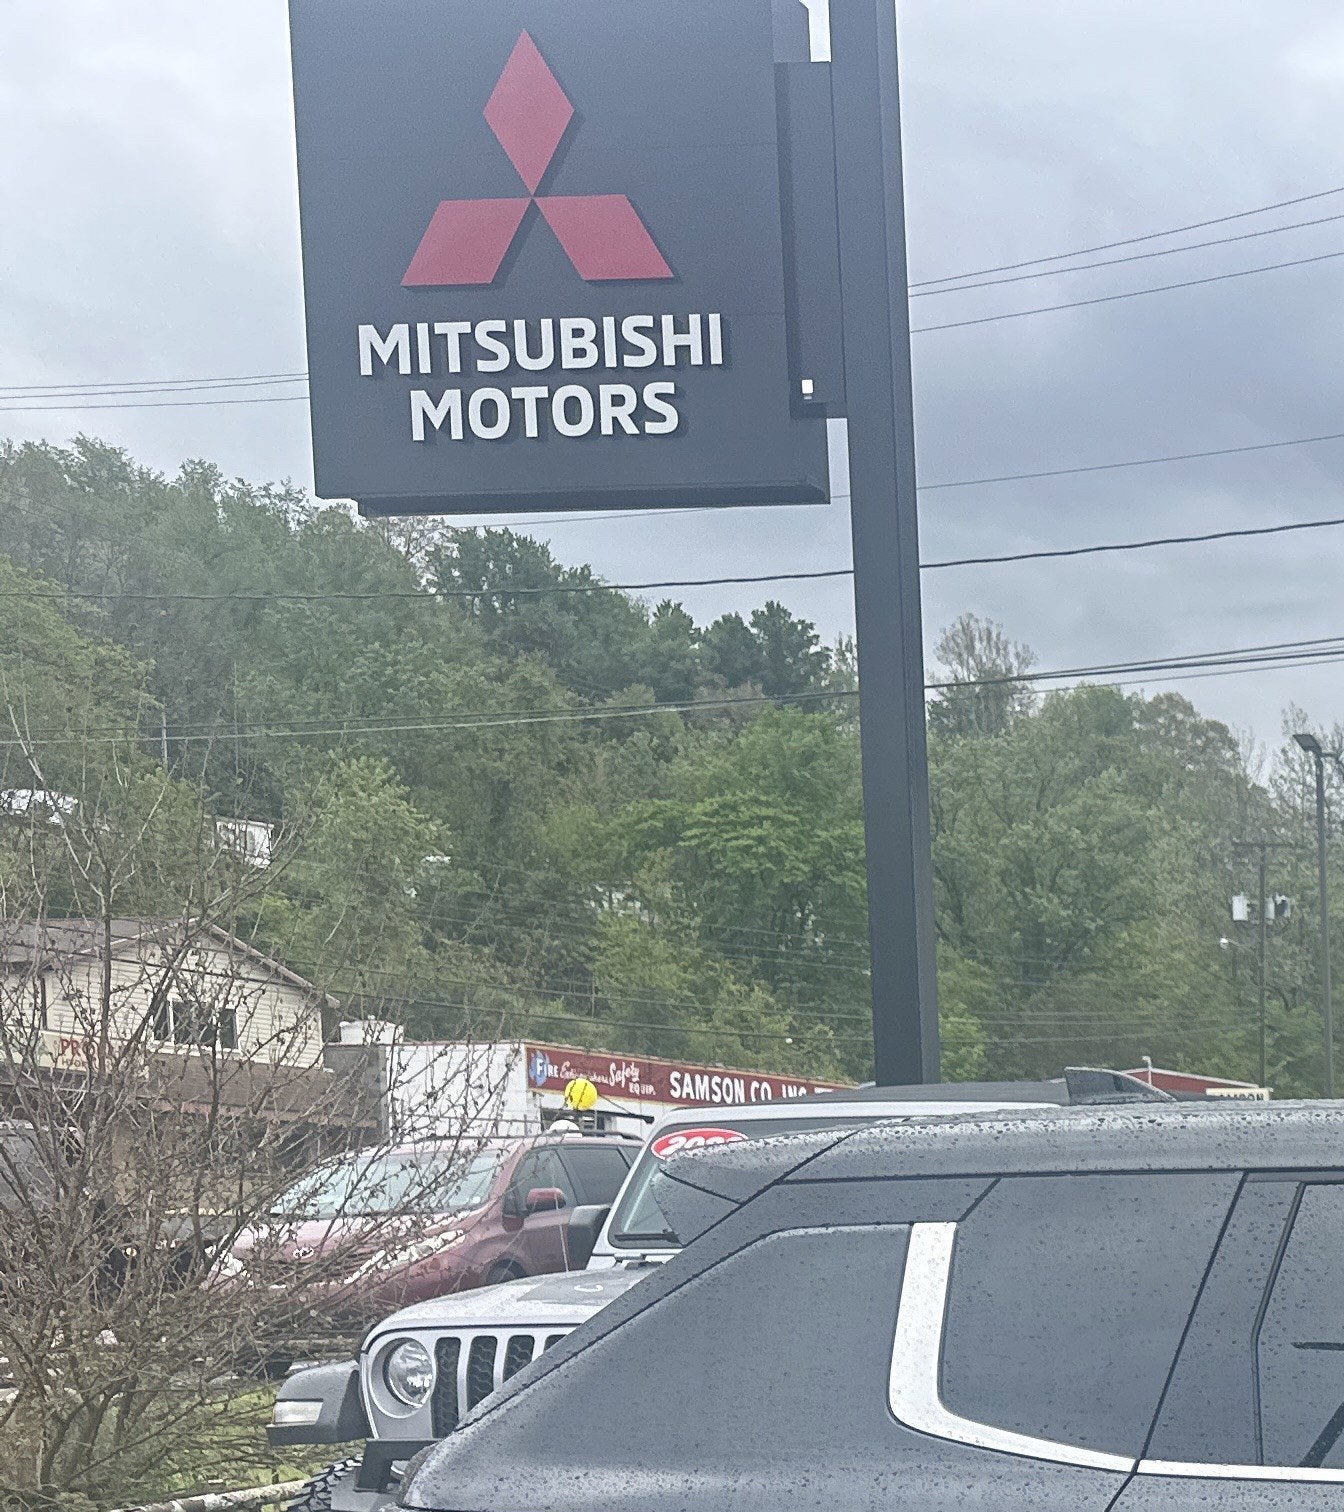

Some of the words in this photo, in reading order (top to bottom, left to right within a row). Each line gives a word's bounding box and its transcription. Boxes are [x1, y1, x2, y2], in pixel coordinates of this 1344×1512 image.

[358, 313, 723, 376] MITSUBISHI
[410, 381, 680, 442] MOTORS
[608, 1061, 640, 1088] Safety
[669, 1071, 746, 1104] SAMSON
